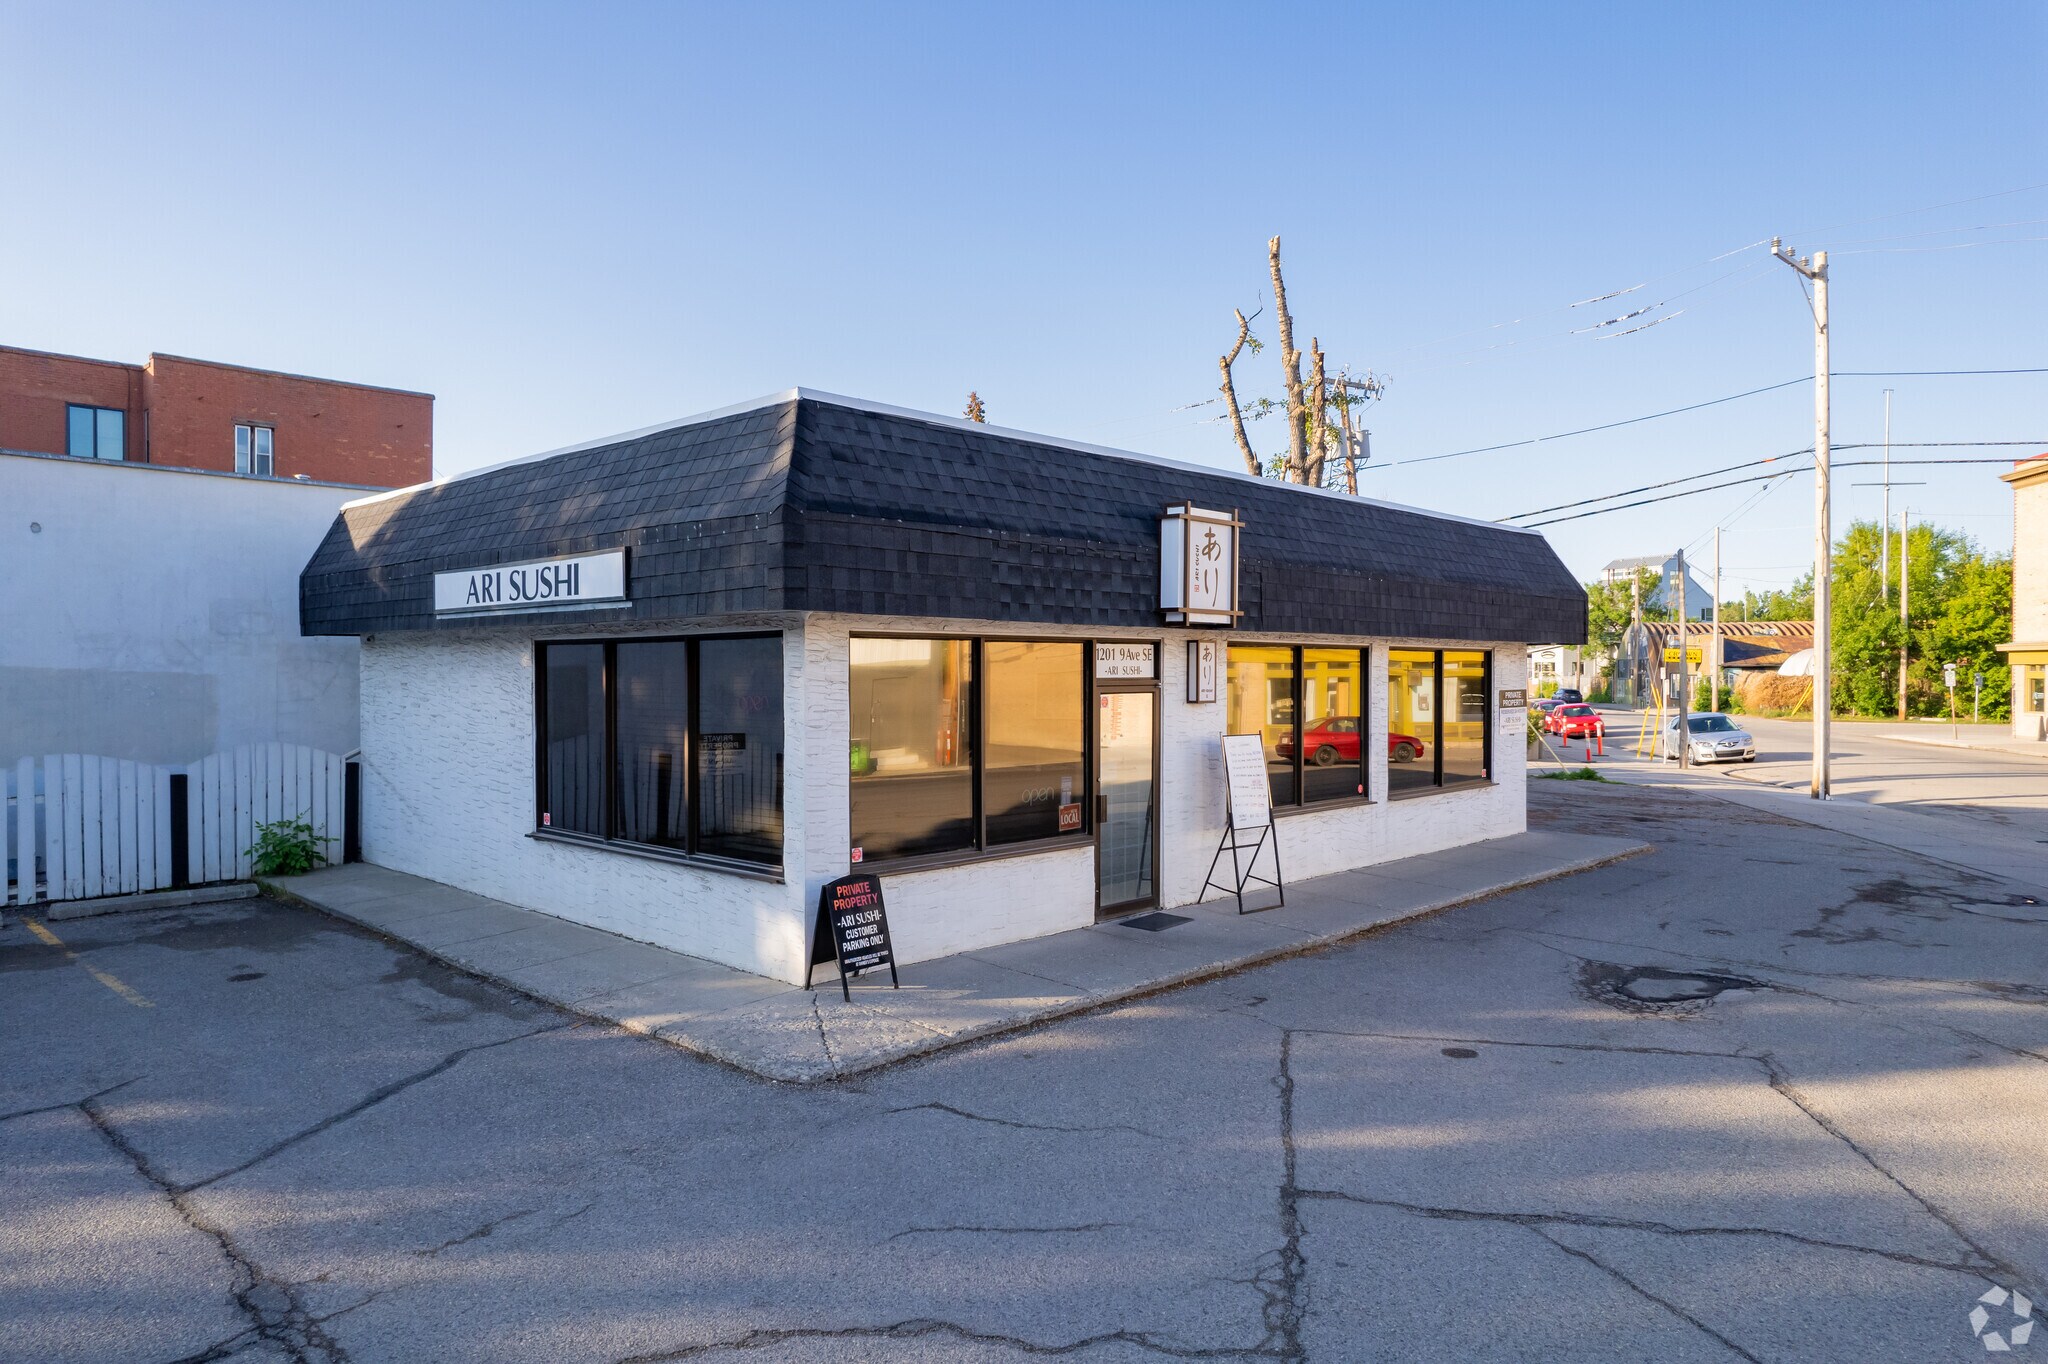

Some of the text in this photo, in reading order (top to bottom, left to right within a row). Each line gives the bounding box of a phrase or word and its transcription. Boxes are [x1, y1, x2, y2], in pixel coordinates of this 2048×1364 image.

[1201, 526, 1221, 607] あり
[466, 562, 580, 605] ARI SUSHI
[1096, 647, 1115, 661] 1201
[1142, 648, 1152, 661] SE
[1202, 644, 1213, 685] あり
[1502, 699, 1525, 707] PROPERTY
[1504, 691, 1522, 699] PRIVATE
[1021, 786, 1055, 806] open
[1060, 812, 1080, 825] LOCAL
[836, 881, 871, 898] PRIVATE
[833, 892, 878, 911] PROPERTY
[845, 924, 878, 939] CUSTOMER
[842, 934, 884, 952] PARKING ONLY
